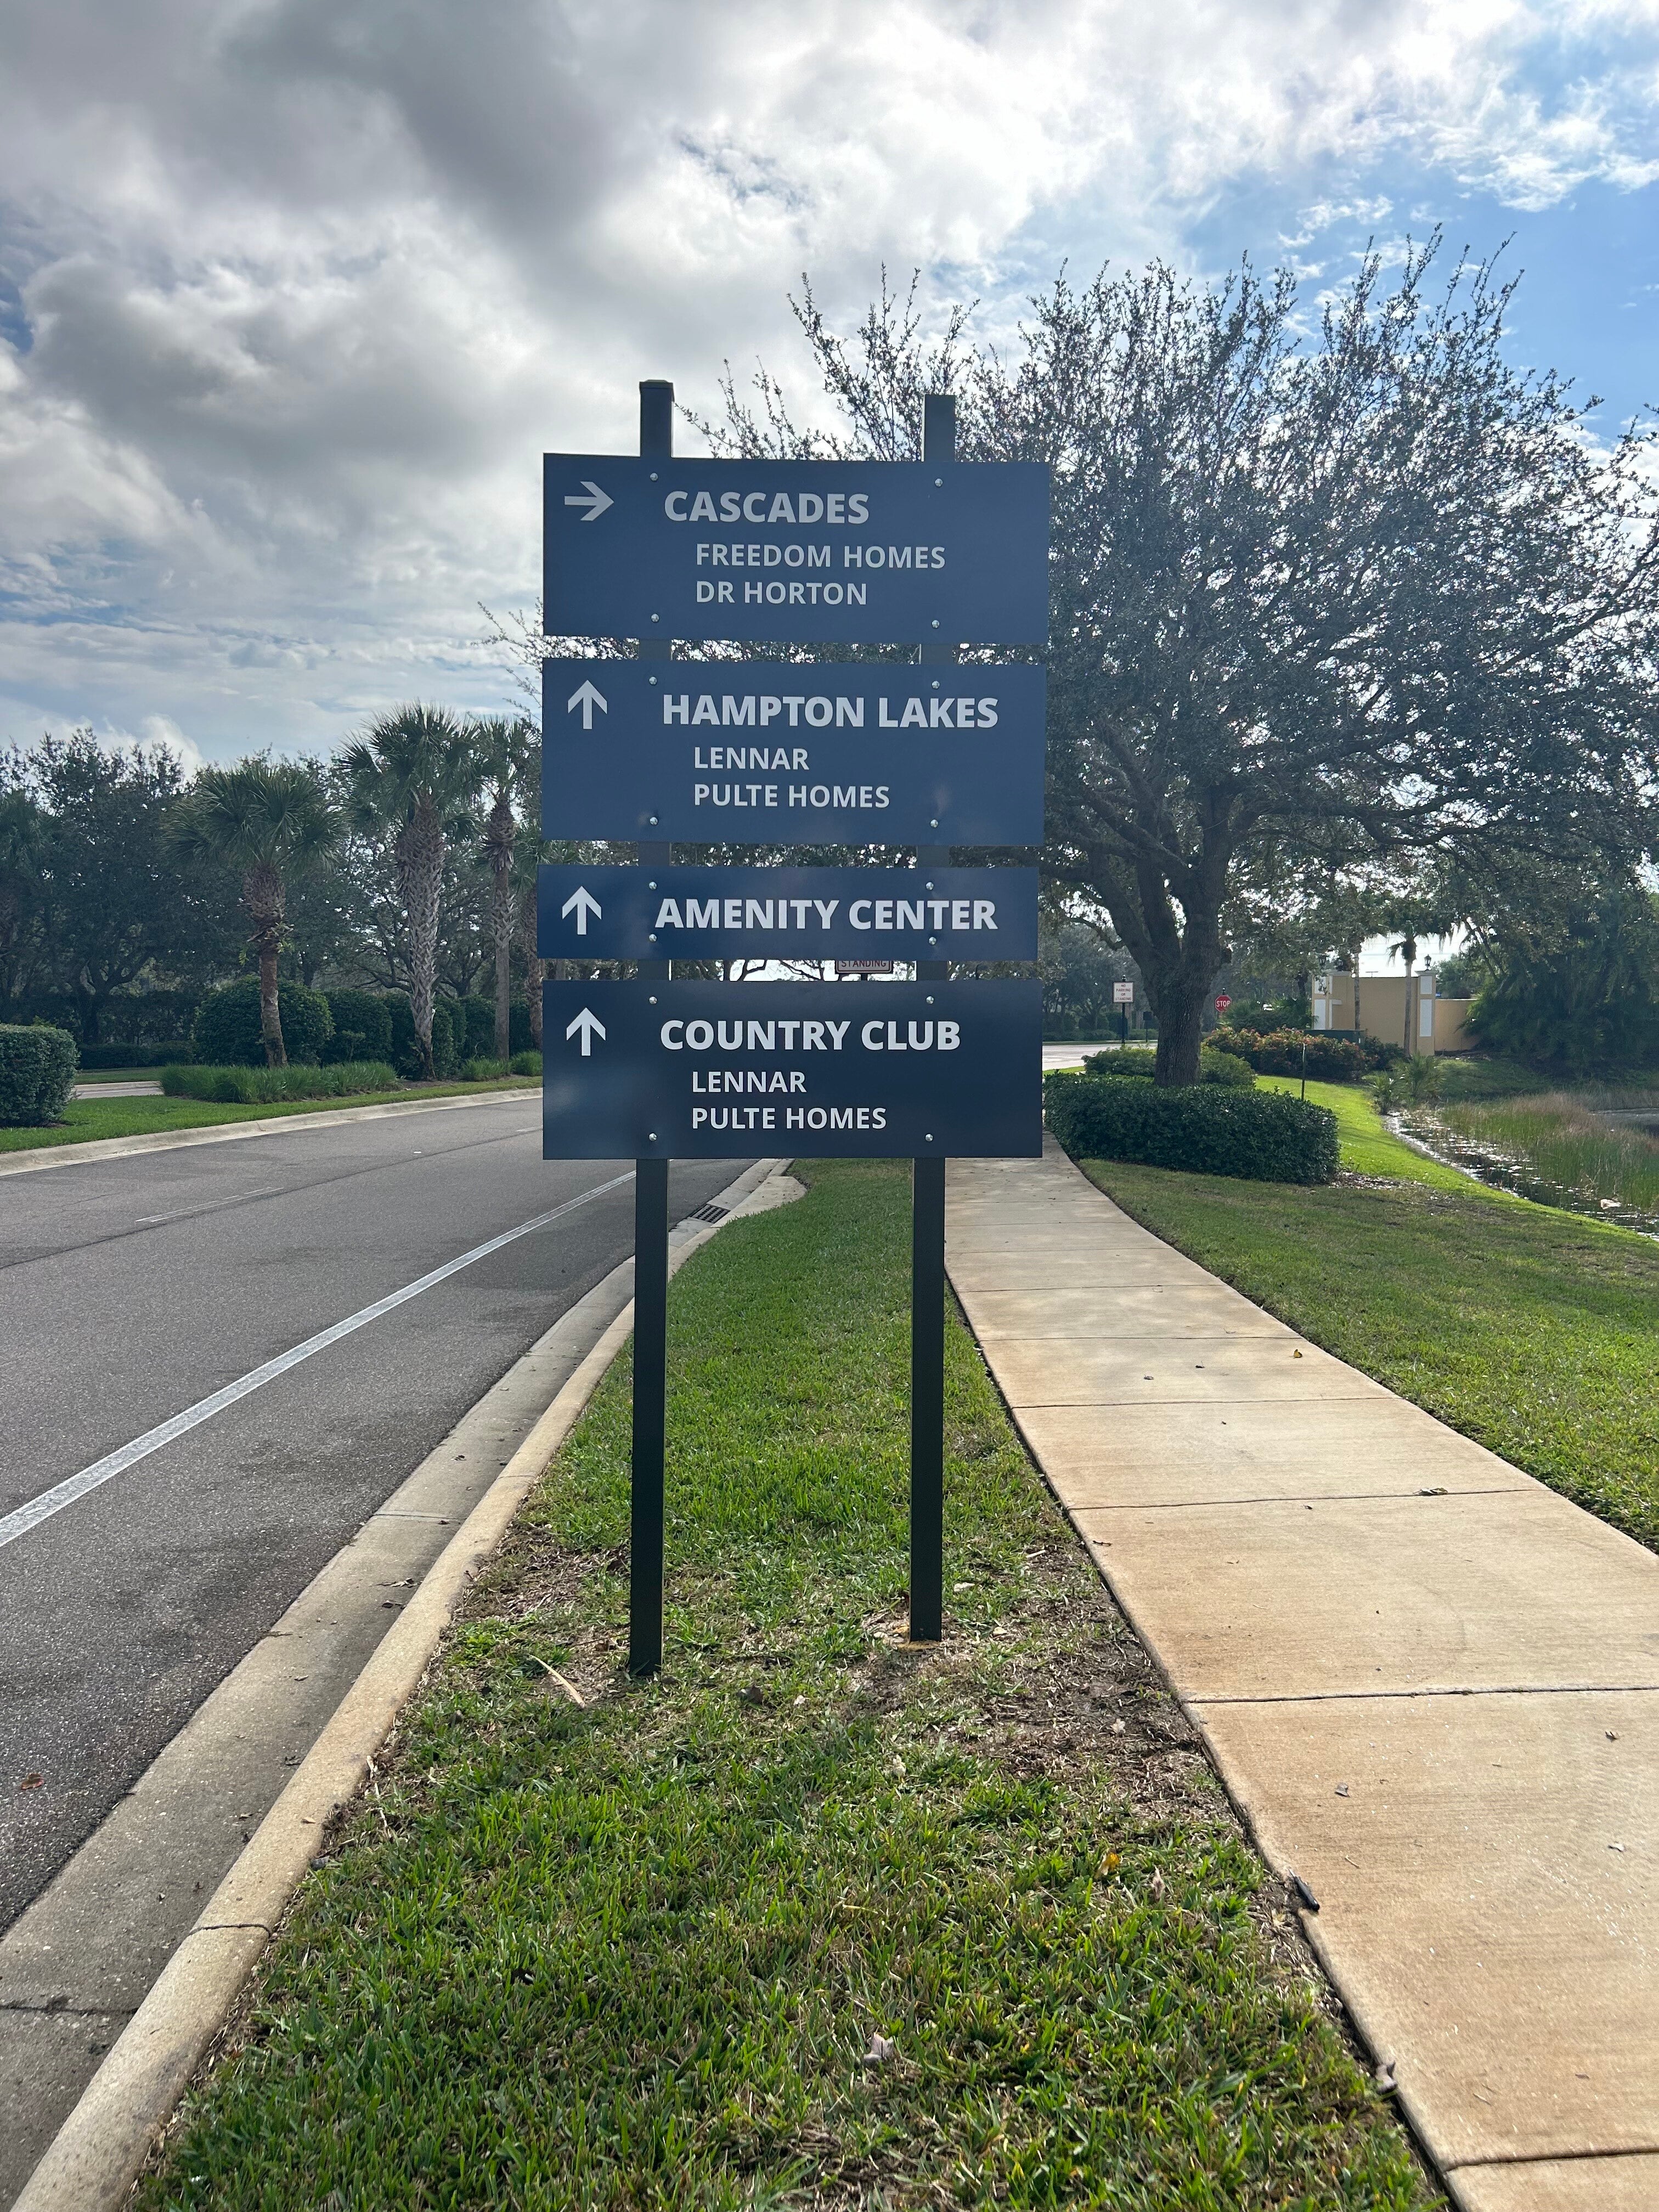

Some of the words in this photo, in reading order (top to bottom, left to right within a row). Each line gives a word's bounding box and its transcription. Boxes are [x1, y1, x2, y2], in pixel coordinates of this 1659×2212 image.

[665, 491, 868, 524] CASCADES
[697, 544, 830, 567] FREEDOM
[845, 546, 945, 568] HOMES
[697, 581, 735, 603] DR
[745, 582, 866, 605] HORTON
[664, 695, 864, 727] HAMPTON
[879, 698, 997, 727] LAKES
[695, 747, 809, 770] LENNAR
[695, 784, 777, 806] PULTE
[789, 786, 889, 808] HOMES
[655, 899, 839, 929] AMENITY
[849, 900, 998, 929] CENTER
[661, 1020, 851, 1049] COUNTRY
[862, 1021, 960, 1050] CLUB
[693, 1071, 806, 1092] LENNAR
[693, 1108, 775, 1128] PULTE
[787, 1108, 886, 1128] HOMES
